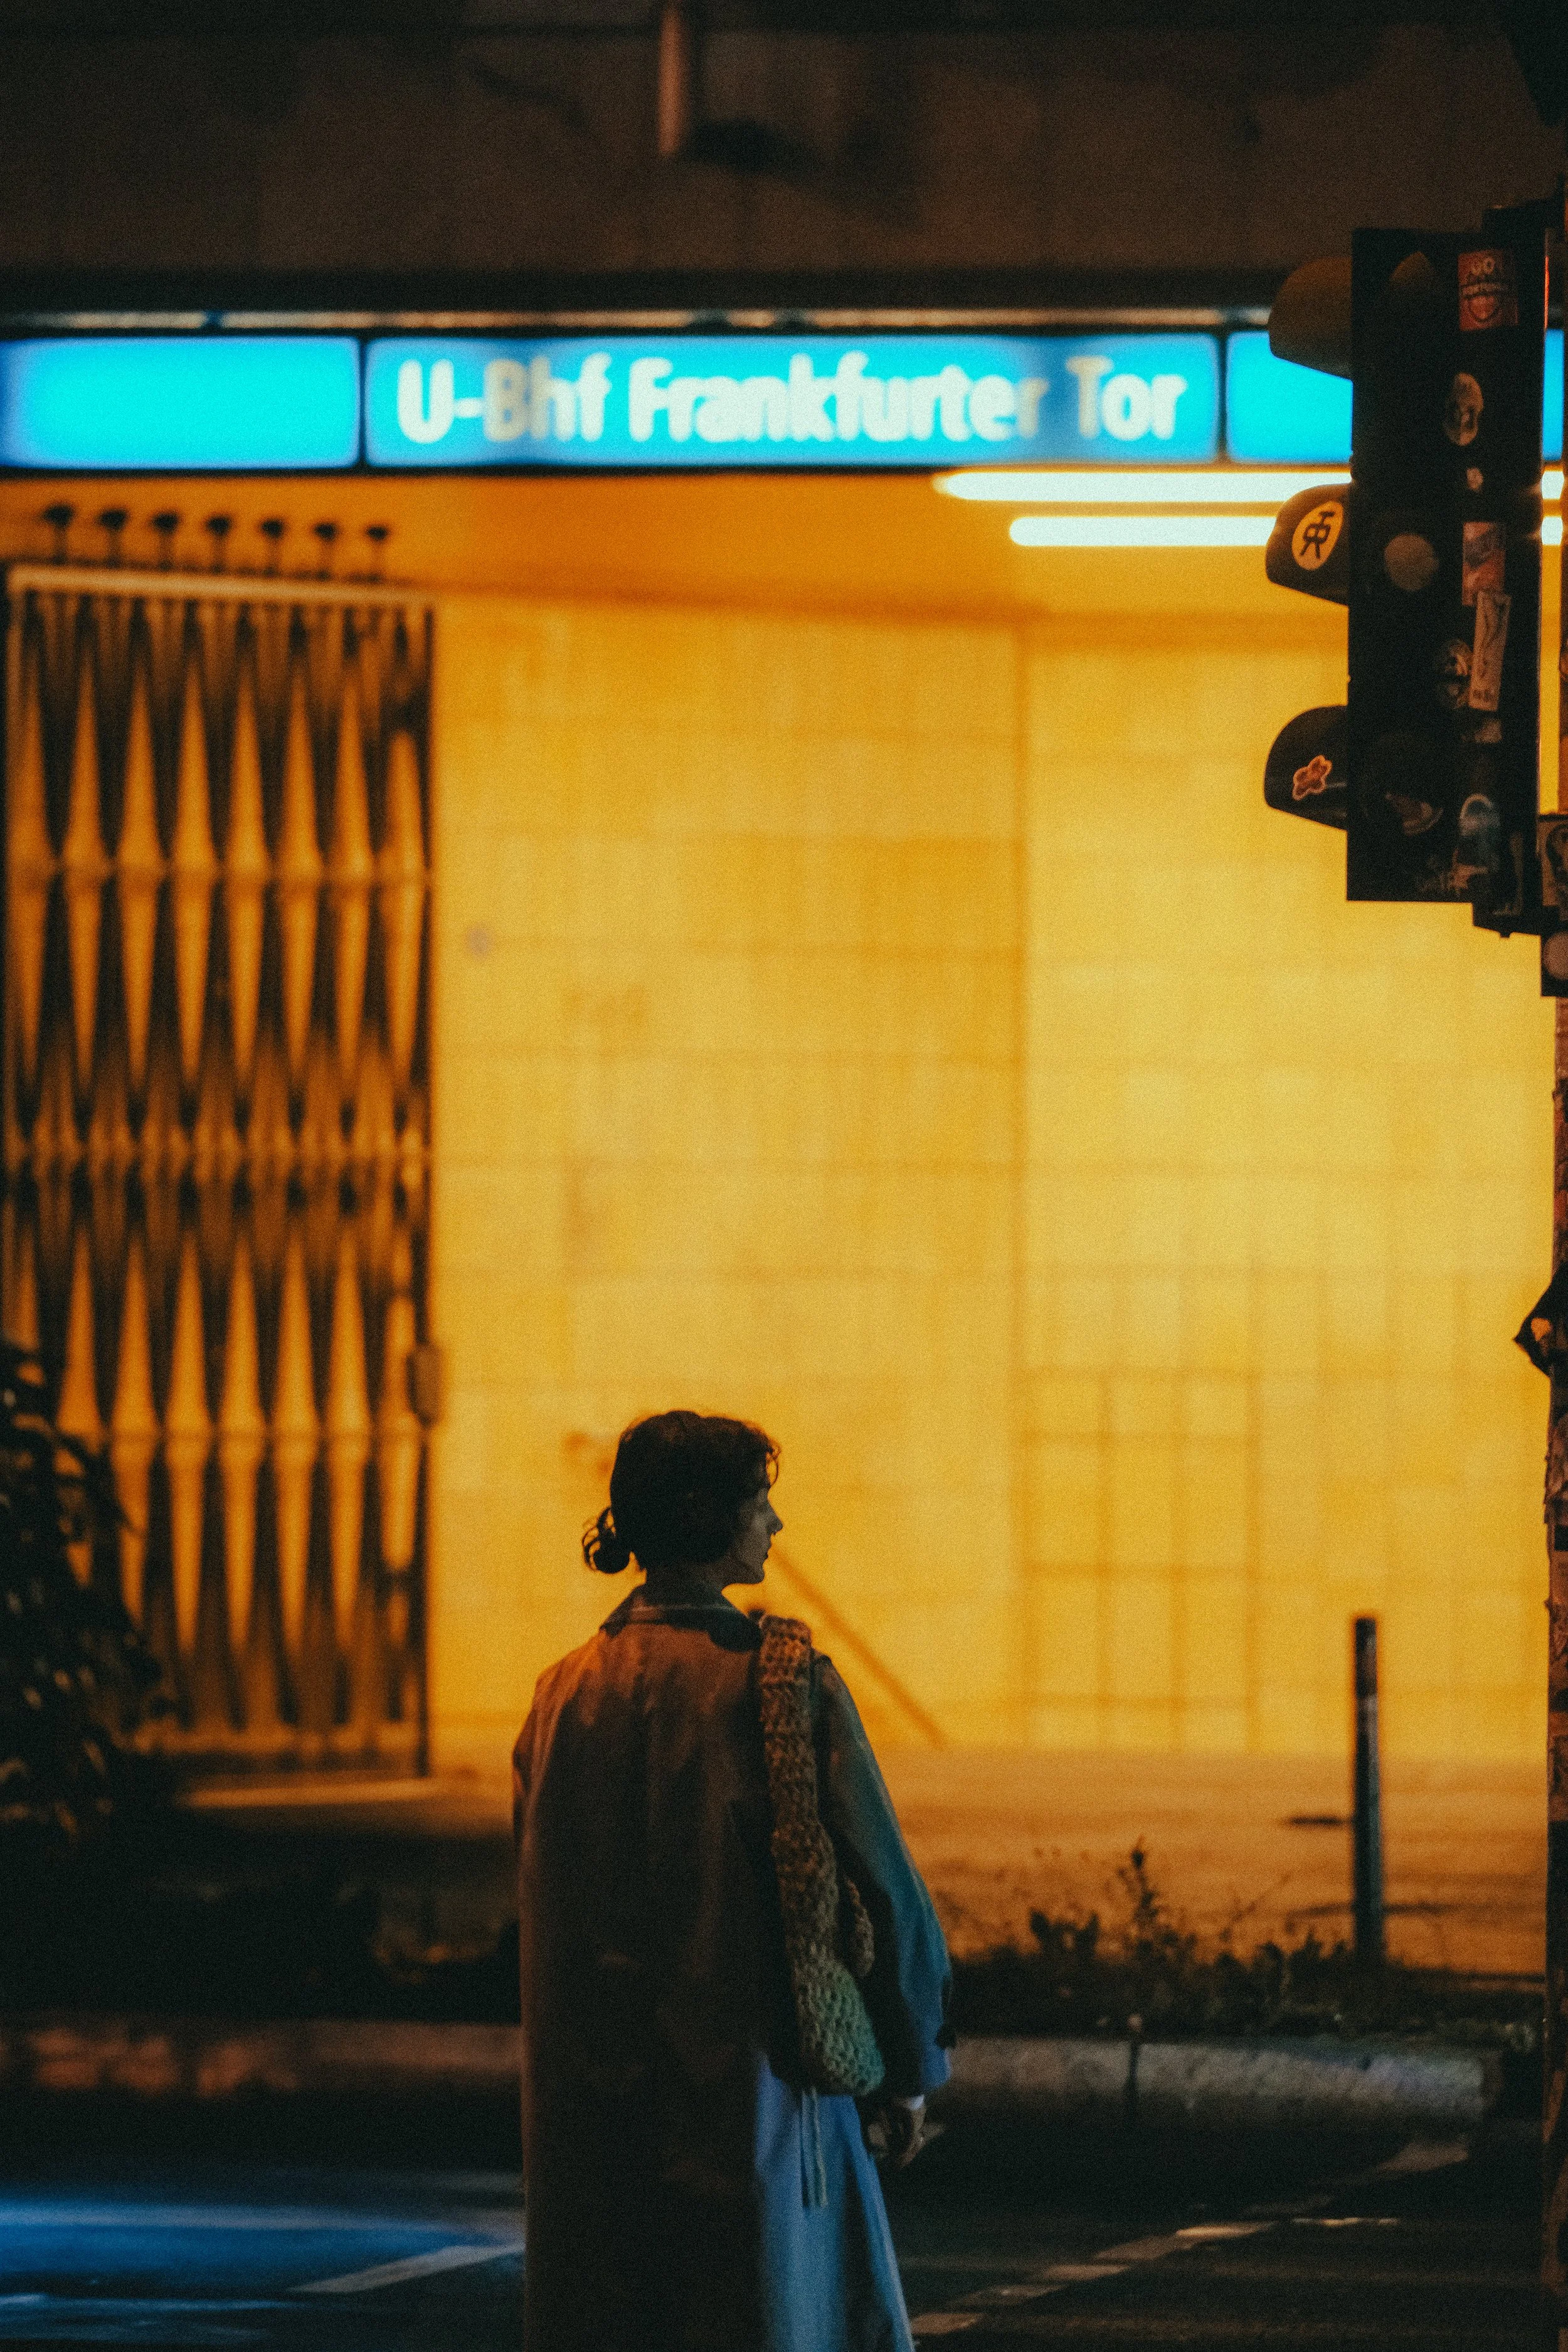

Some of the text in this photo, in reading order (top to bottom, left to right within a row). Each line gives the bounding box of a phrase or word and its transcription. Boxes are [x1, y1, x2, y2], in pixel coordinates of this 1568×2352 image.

[397, 350, 1187, 443] U-Bhf Frankfurter Tor
